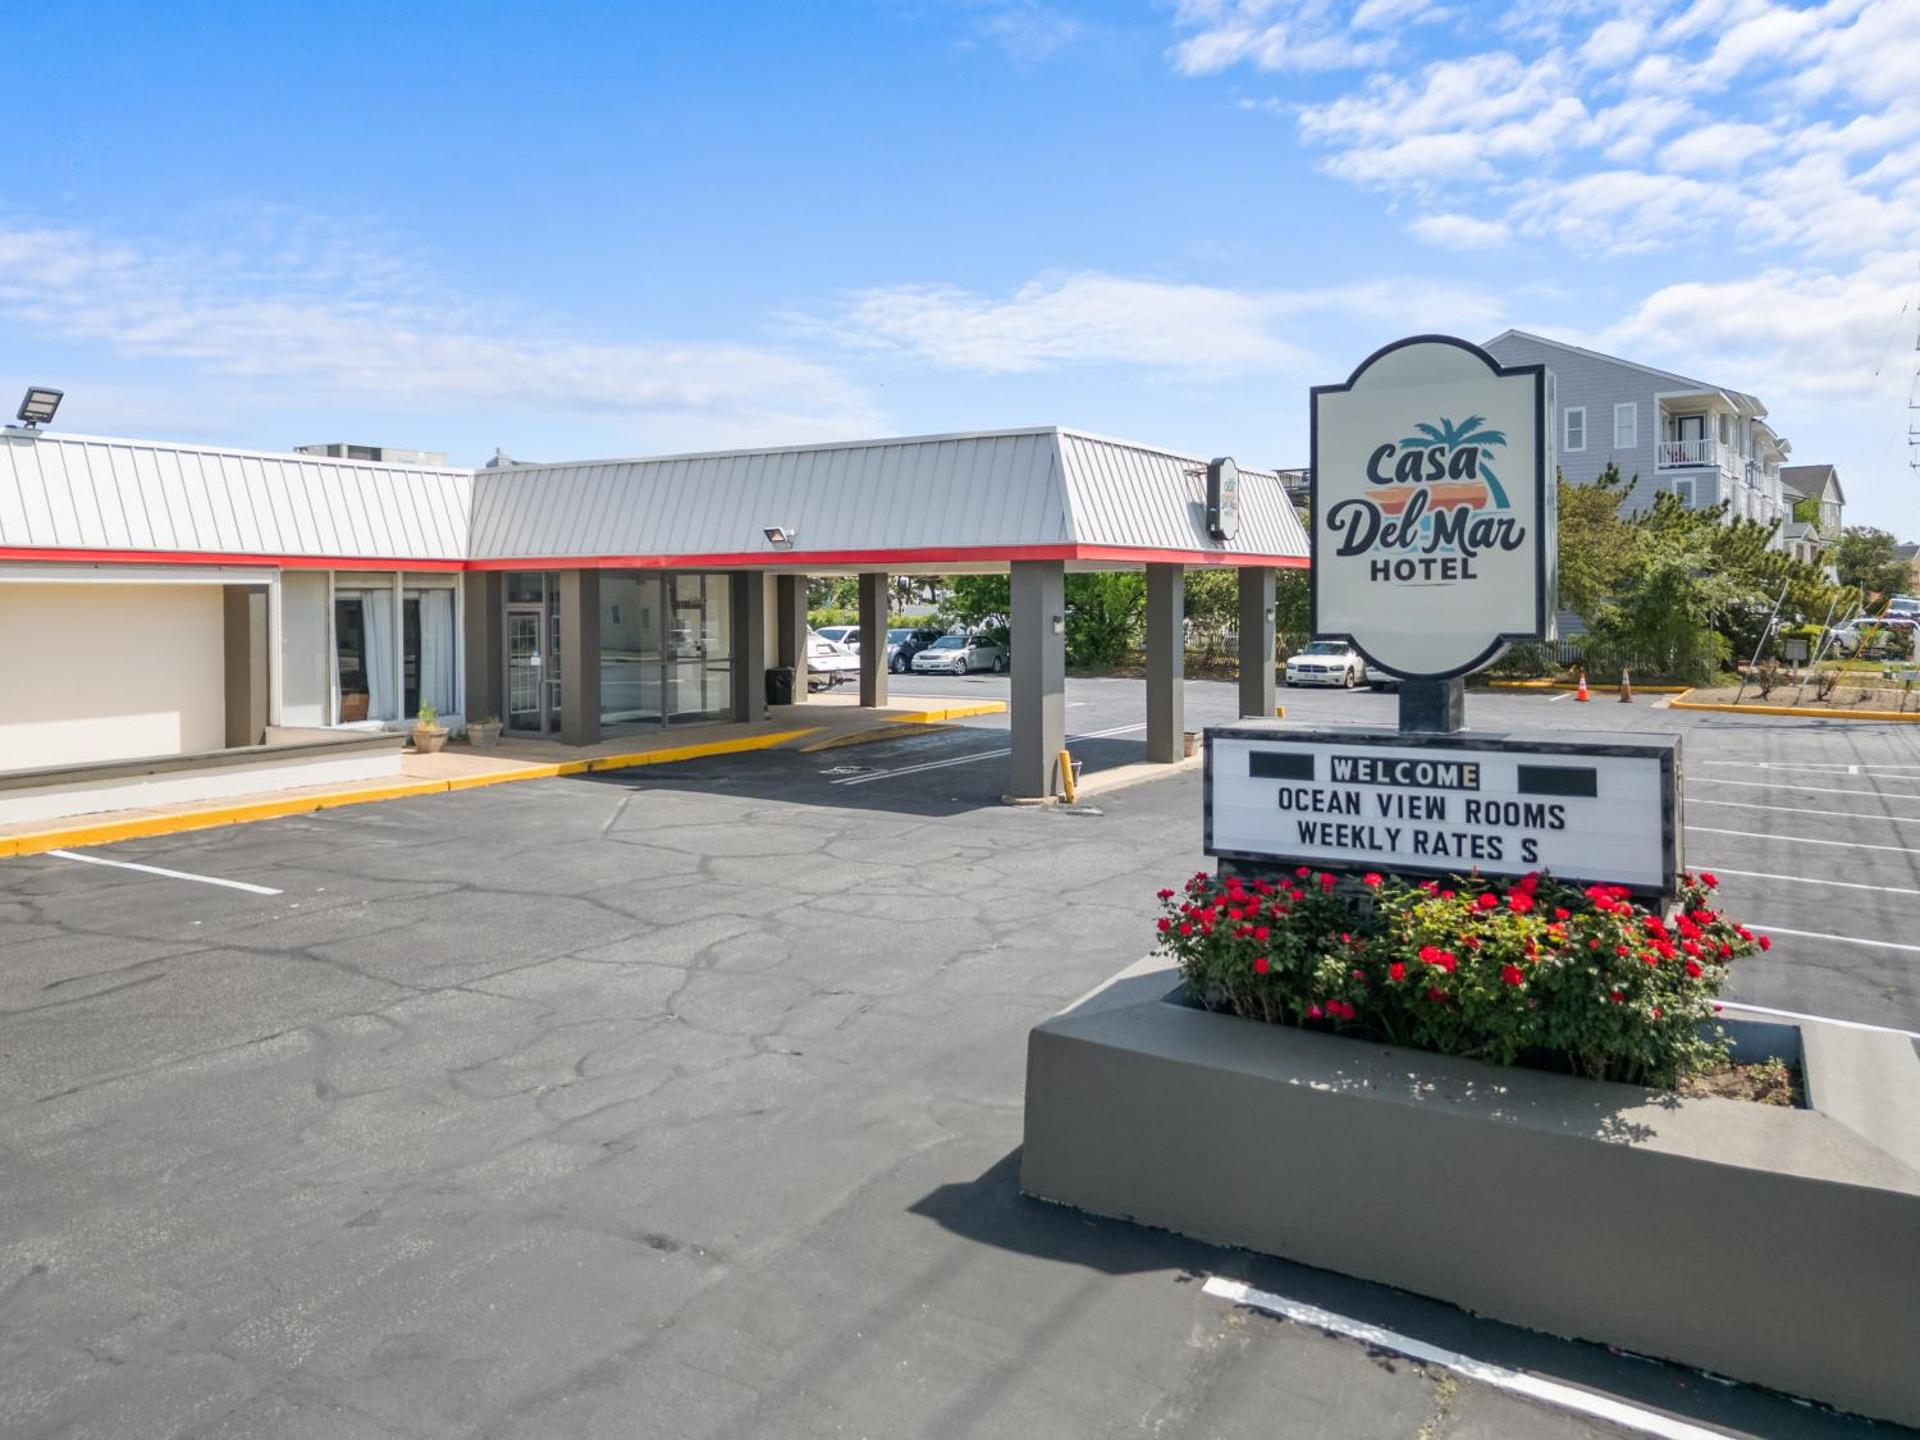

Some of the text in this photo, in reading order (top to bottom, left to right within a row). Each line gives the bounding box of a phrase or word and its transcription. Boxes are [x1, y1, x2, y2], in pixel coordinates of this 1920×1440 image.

[1366, 444, 1479, 484] Casa
[1326, 489, 1526, 558] Del Mar
[1370, 557, 1478, 582] HOTEL
[1333, 758, 1477, 788] WELCOME
[1278, 787, 1565, 830] OCEAN VIEW ROOMS
[1297, 820, 1401, 852] WEEKLY
[1413, 829, 1503, 861] RATES
